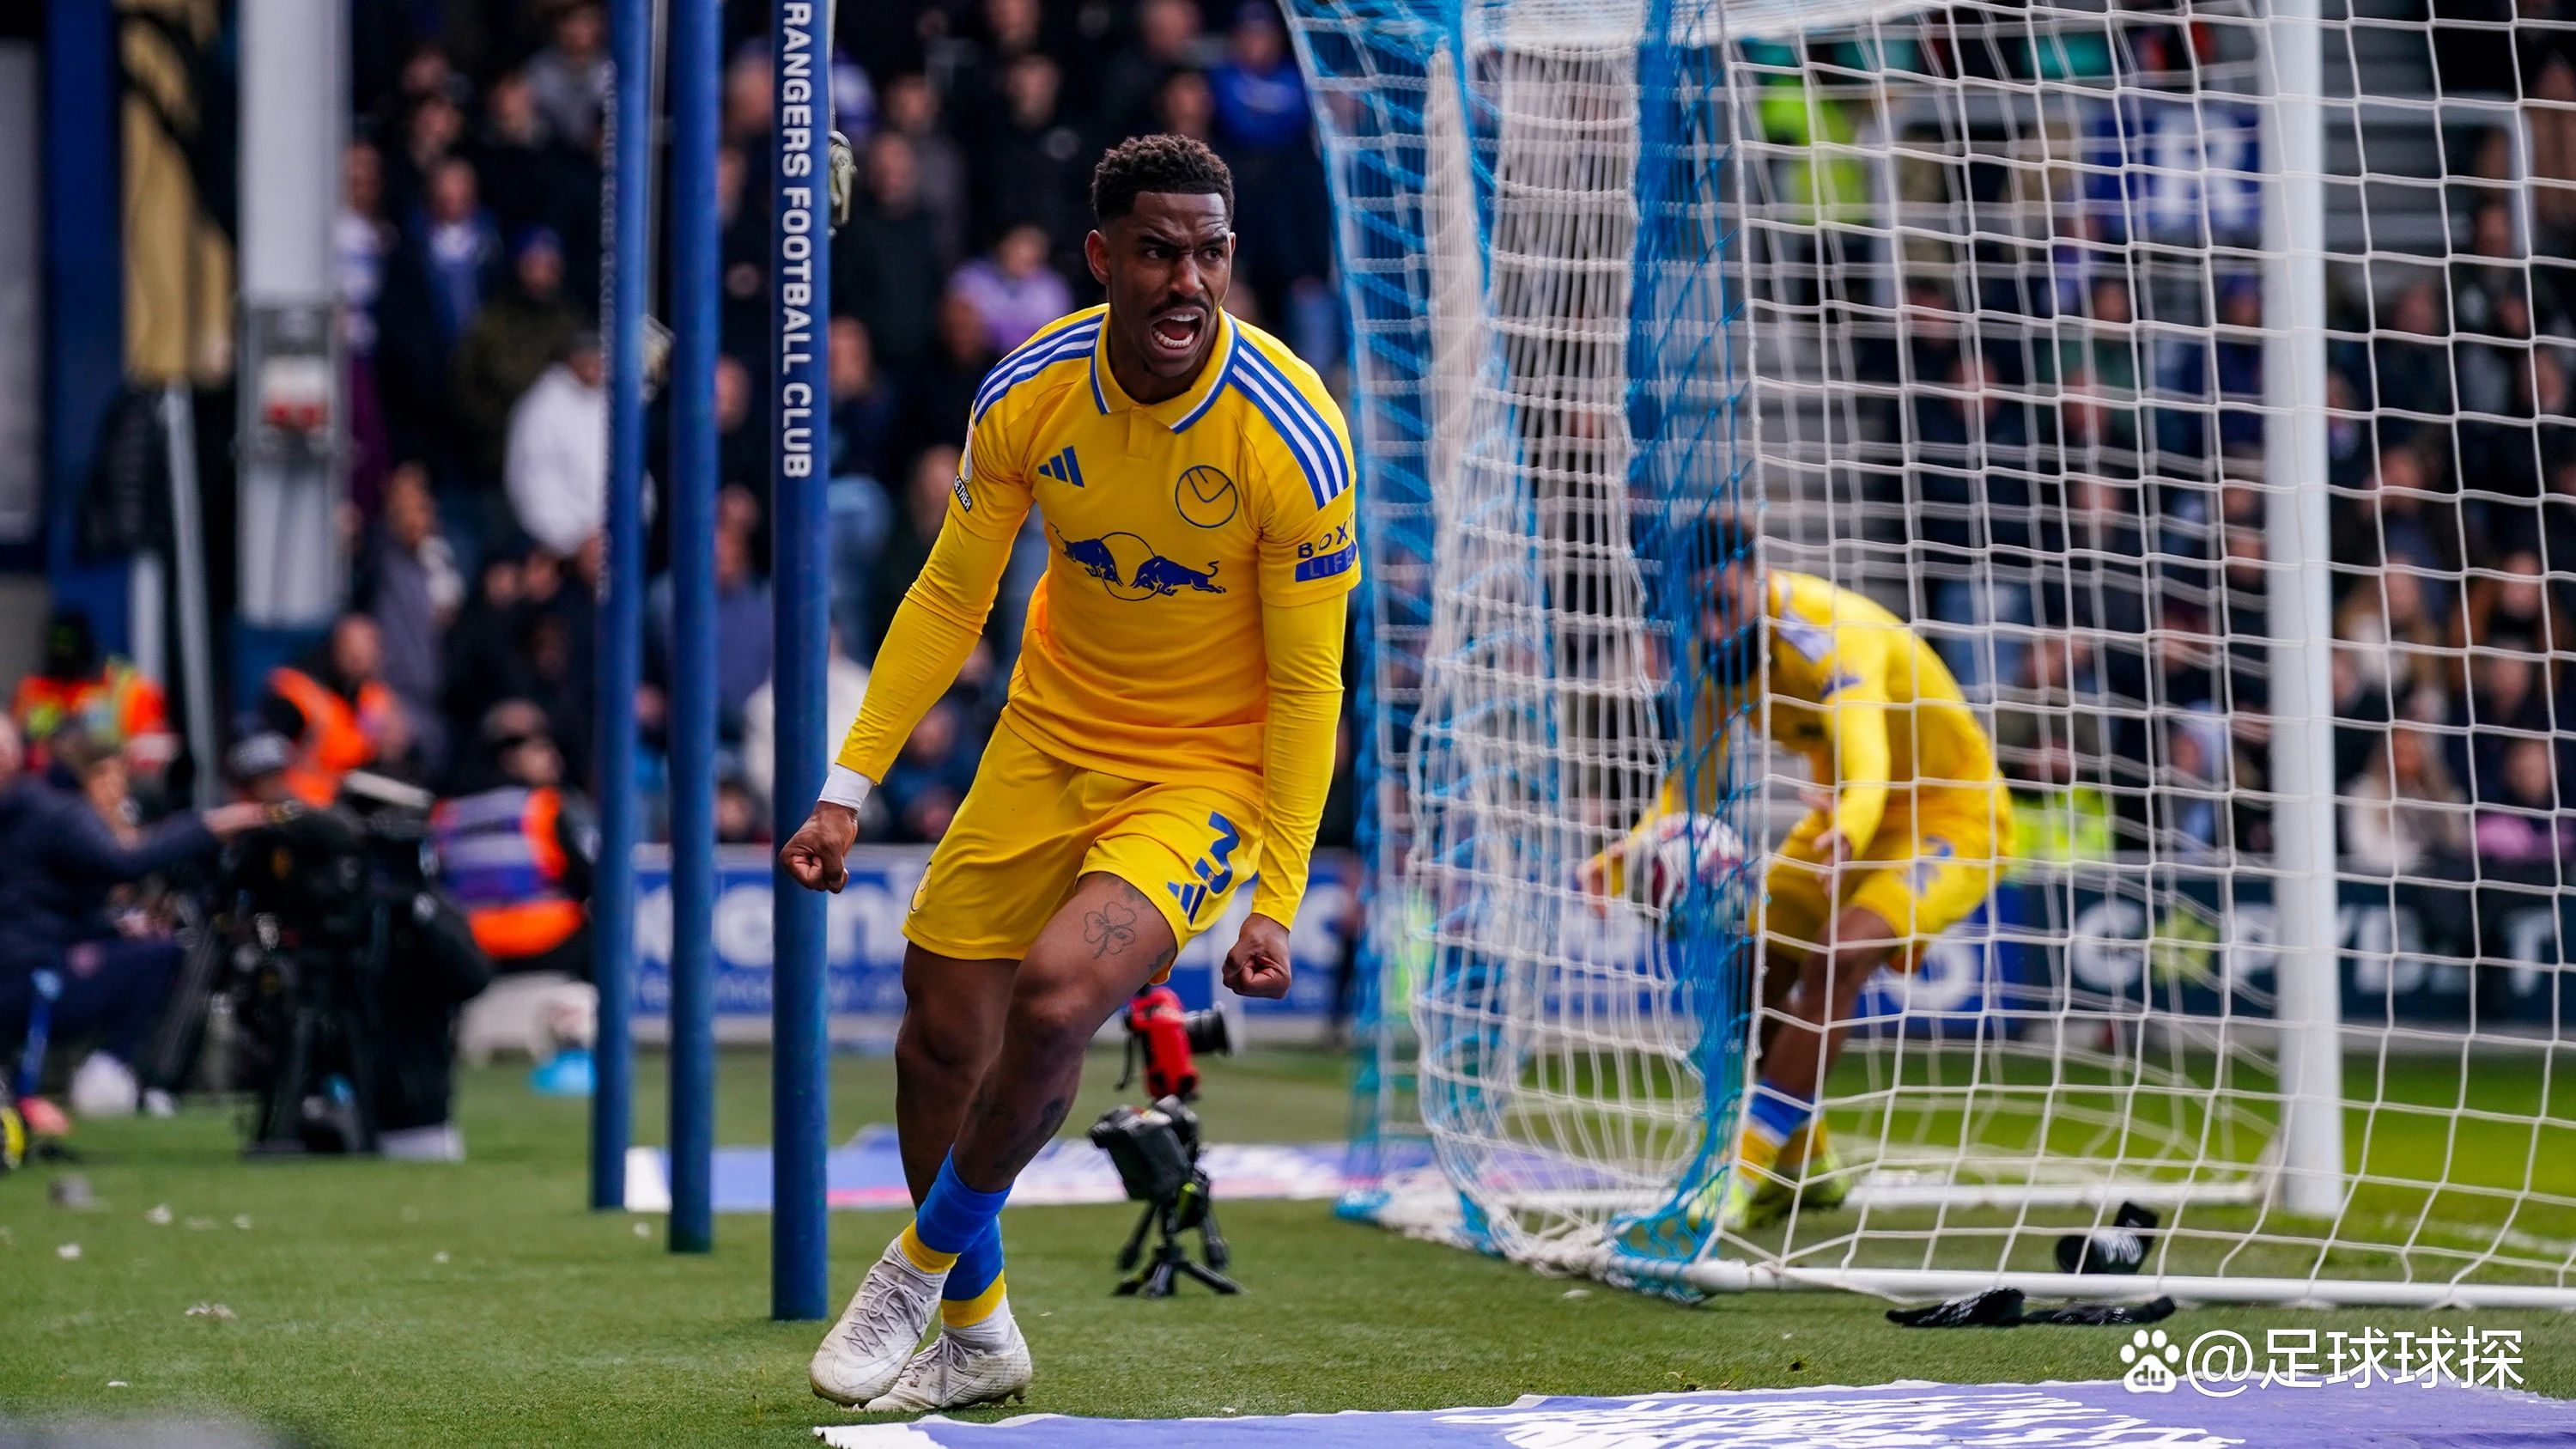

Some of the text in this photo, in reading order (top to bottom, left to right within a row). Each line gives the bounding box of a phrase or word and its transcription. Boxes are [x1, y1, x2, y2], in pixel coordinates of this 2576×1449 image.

[782, 2, 812, 478] RANGERS FOOTBALL CLUB
[1309, 546, 1355, 578] LIFE
[1194, 810, 1241, 894] 3
